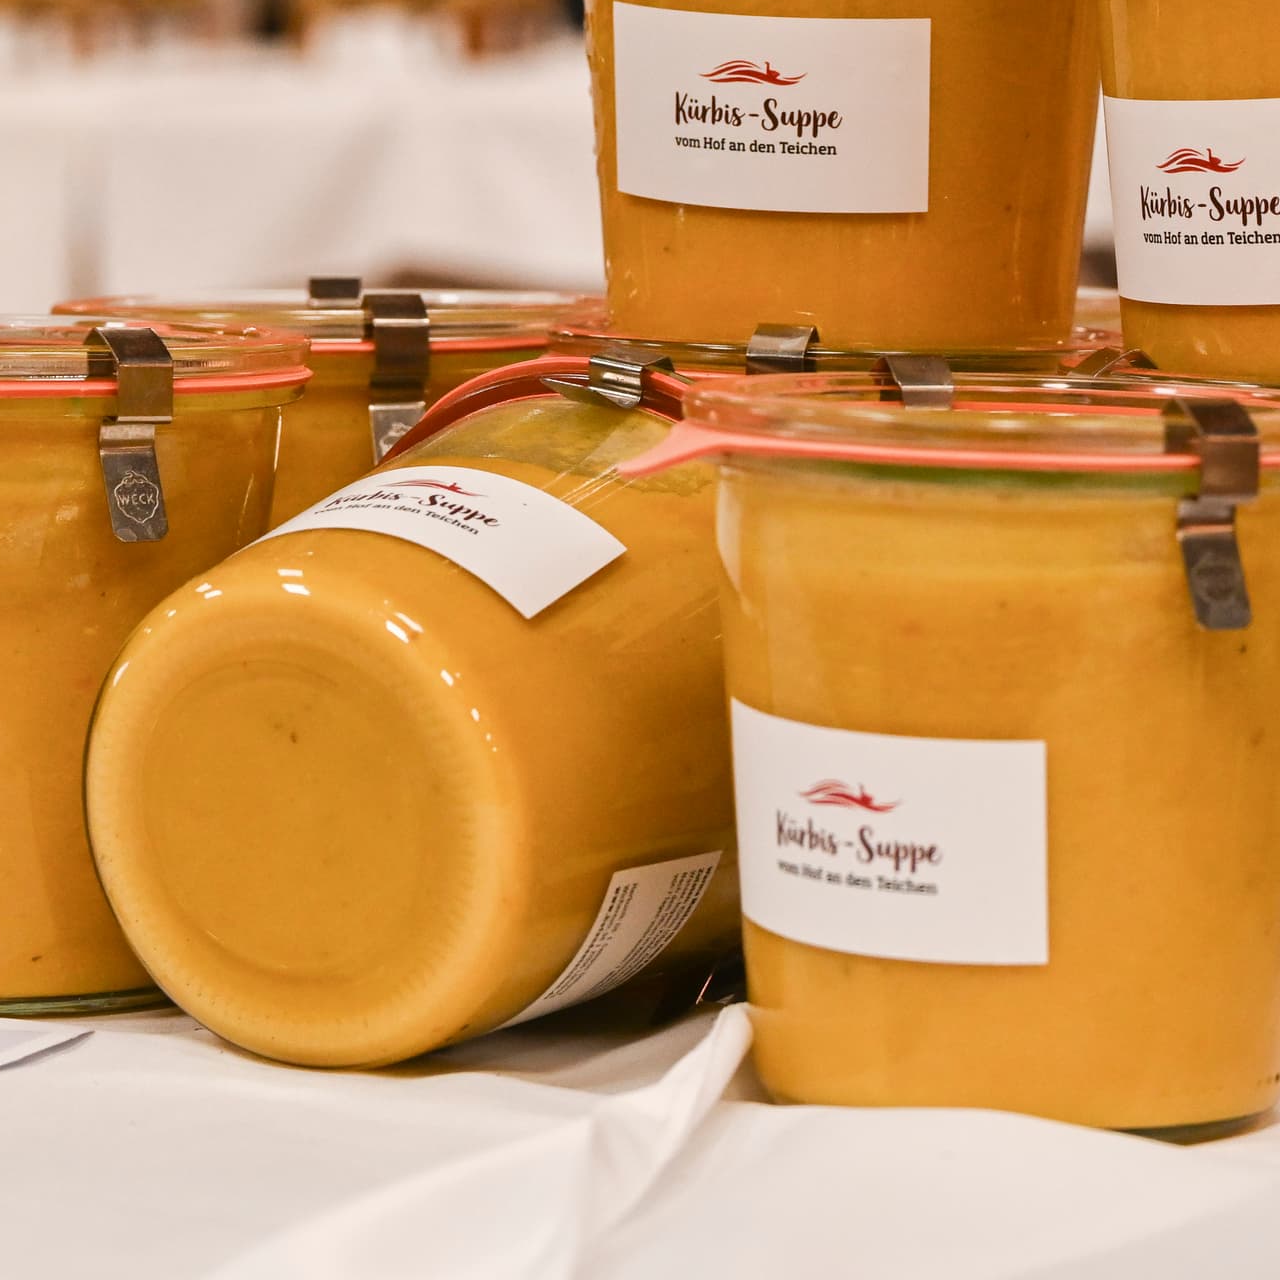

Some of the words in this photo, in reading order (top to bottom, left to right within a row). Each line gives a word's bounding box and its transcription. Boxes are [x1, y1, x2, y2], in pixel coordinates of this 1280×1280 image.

[675, 91, 843, 137] Kürbis-Suppe
[675, 136, 701, 149] vom
[703, 137, 726, 151] Hof
[729, 141, 746, 152] an
[749, 140, 776, 154] den
[779, 141, 837, 156] Teichen
[1143, 232, 1162, 245] vom
[1164, 231, 1183, 245] Hof
[1184, 234, 1199, 246] an
[1201, 232, 1225, 246] den
[118, 493, 156, 505] WECK
[394, 504, 421, 513] den
[425, 510, 480, 536] Teichen
[776, 808, 942, 873] Kürbis-Suppe
[826, 872, 842, 886] an
[845, 872, 872, 888] den
[877, 875, 938, 895] Teichen
